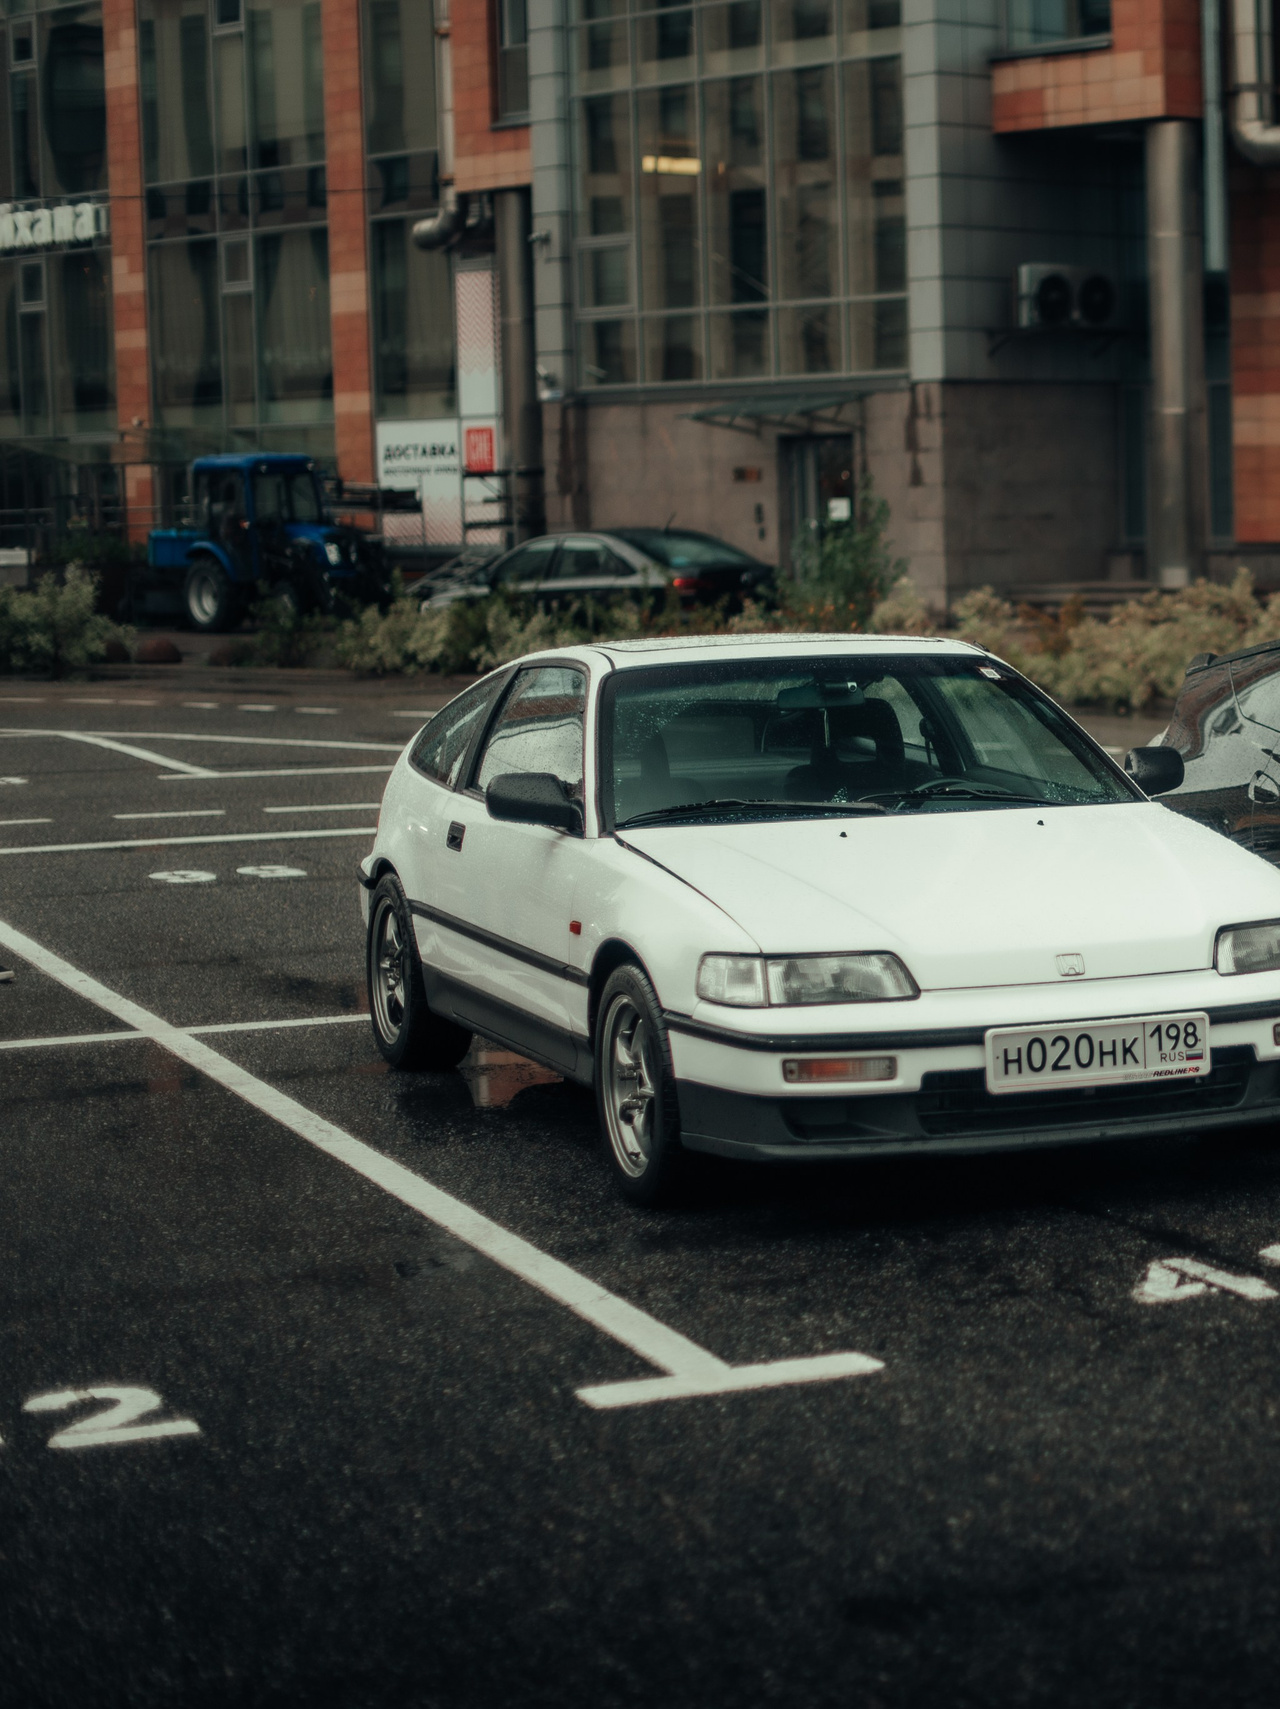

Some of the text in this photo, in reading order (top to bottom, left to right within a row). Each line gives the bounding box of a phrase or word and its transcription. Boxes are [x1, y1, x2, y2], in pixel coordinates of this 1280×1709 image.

[384, 443, 457, 461] ДОСТАВКА
[1149, 1021, 1199, 1052] 198
[1160, 1051, 1185, 1063] RUS
[0, 1387, 201, 1448] 2
